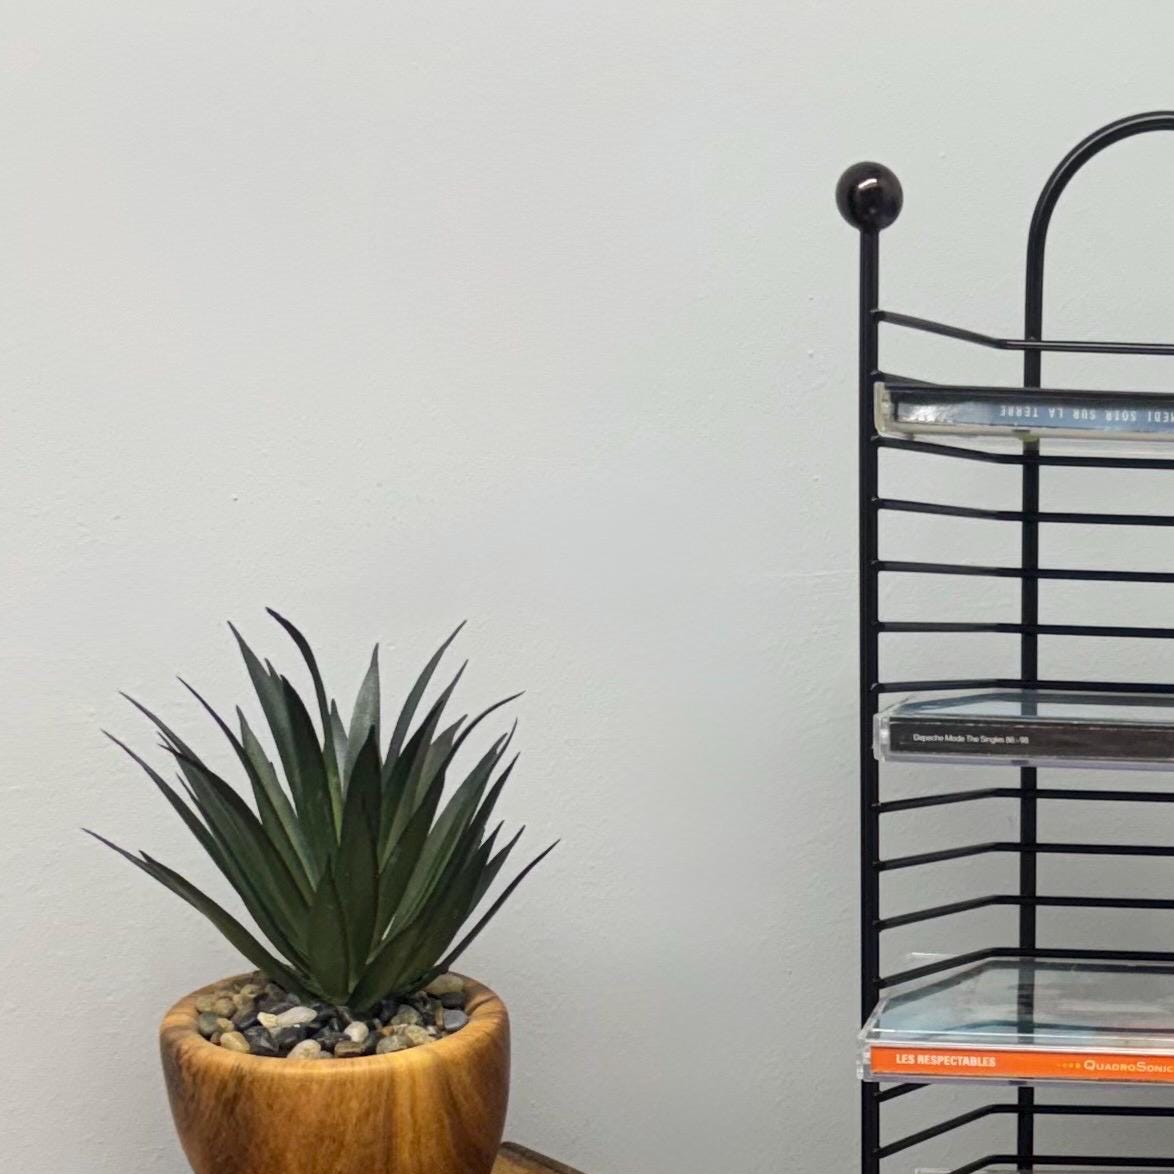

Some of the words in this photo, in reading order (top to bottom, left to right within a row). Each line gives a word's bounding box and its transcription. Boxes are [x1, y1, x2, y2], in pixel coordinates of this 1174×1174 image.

[1000, 405, 1040, 419] TERRE
[1047, 407, 1066, 419] LA
[1072, 408, 1096, 421] SUR
[1106, 409, 1138, 423] SOIR
[944, 733, 966, 743] Mode
[966, 734, 979, 743] The
[980, 735, 1005, 745] Singles
[896, 1053, 915, 1065] LES
[916, 1055, 996, 1067] RESPECTABLES
